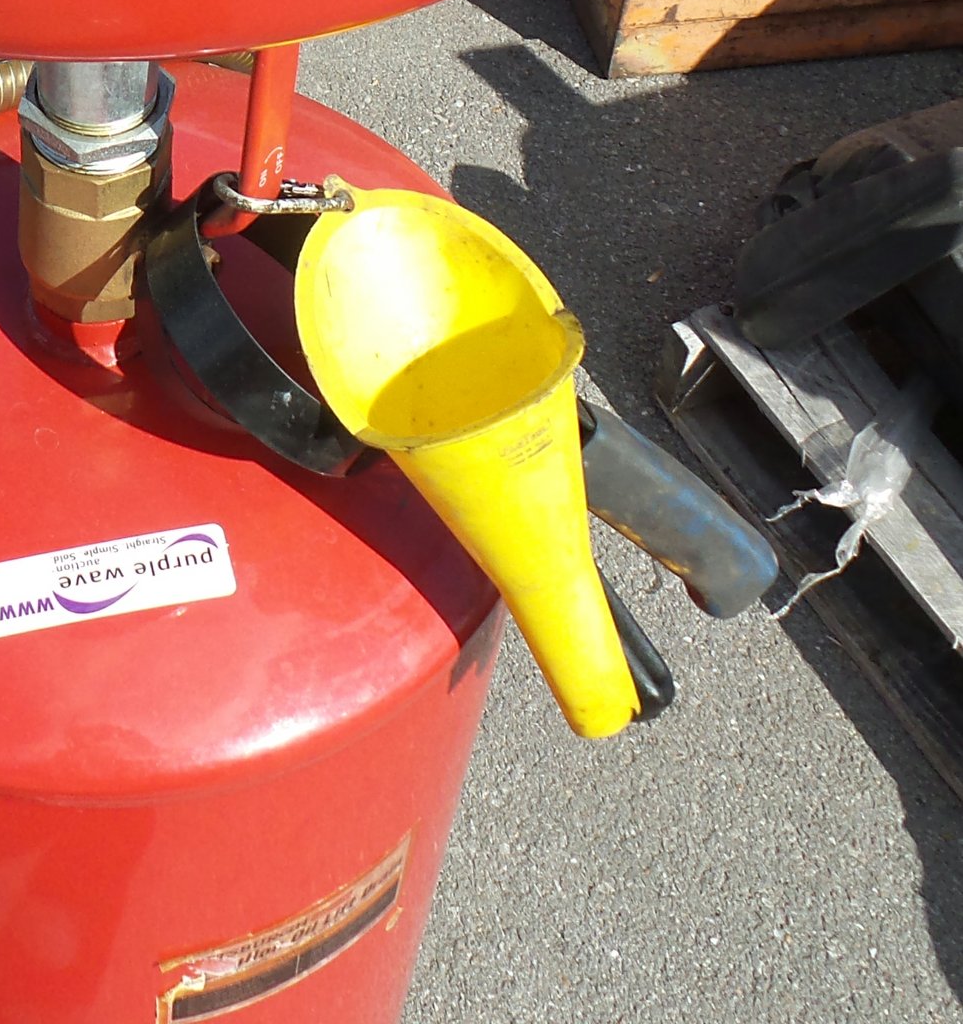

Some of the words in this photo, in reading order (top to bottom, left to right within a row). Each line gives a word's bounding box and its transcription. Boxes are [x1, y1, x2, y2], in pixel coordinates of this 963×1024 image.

[275, 152, 284, 174] OFF
[259, 169, 268, 187] ON
[56, 558, 100, 573] auction
[134, 547, 213, 576] purple
[58, 567, 124, 589] wave
